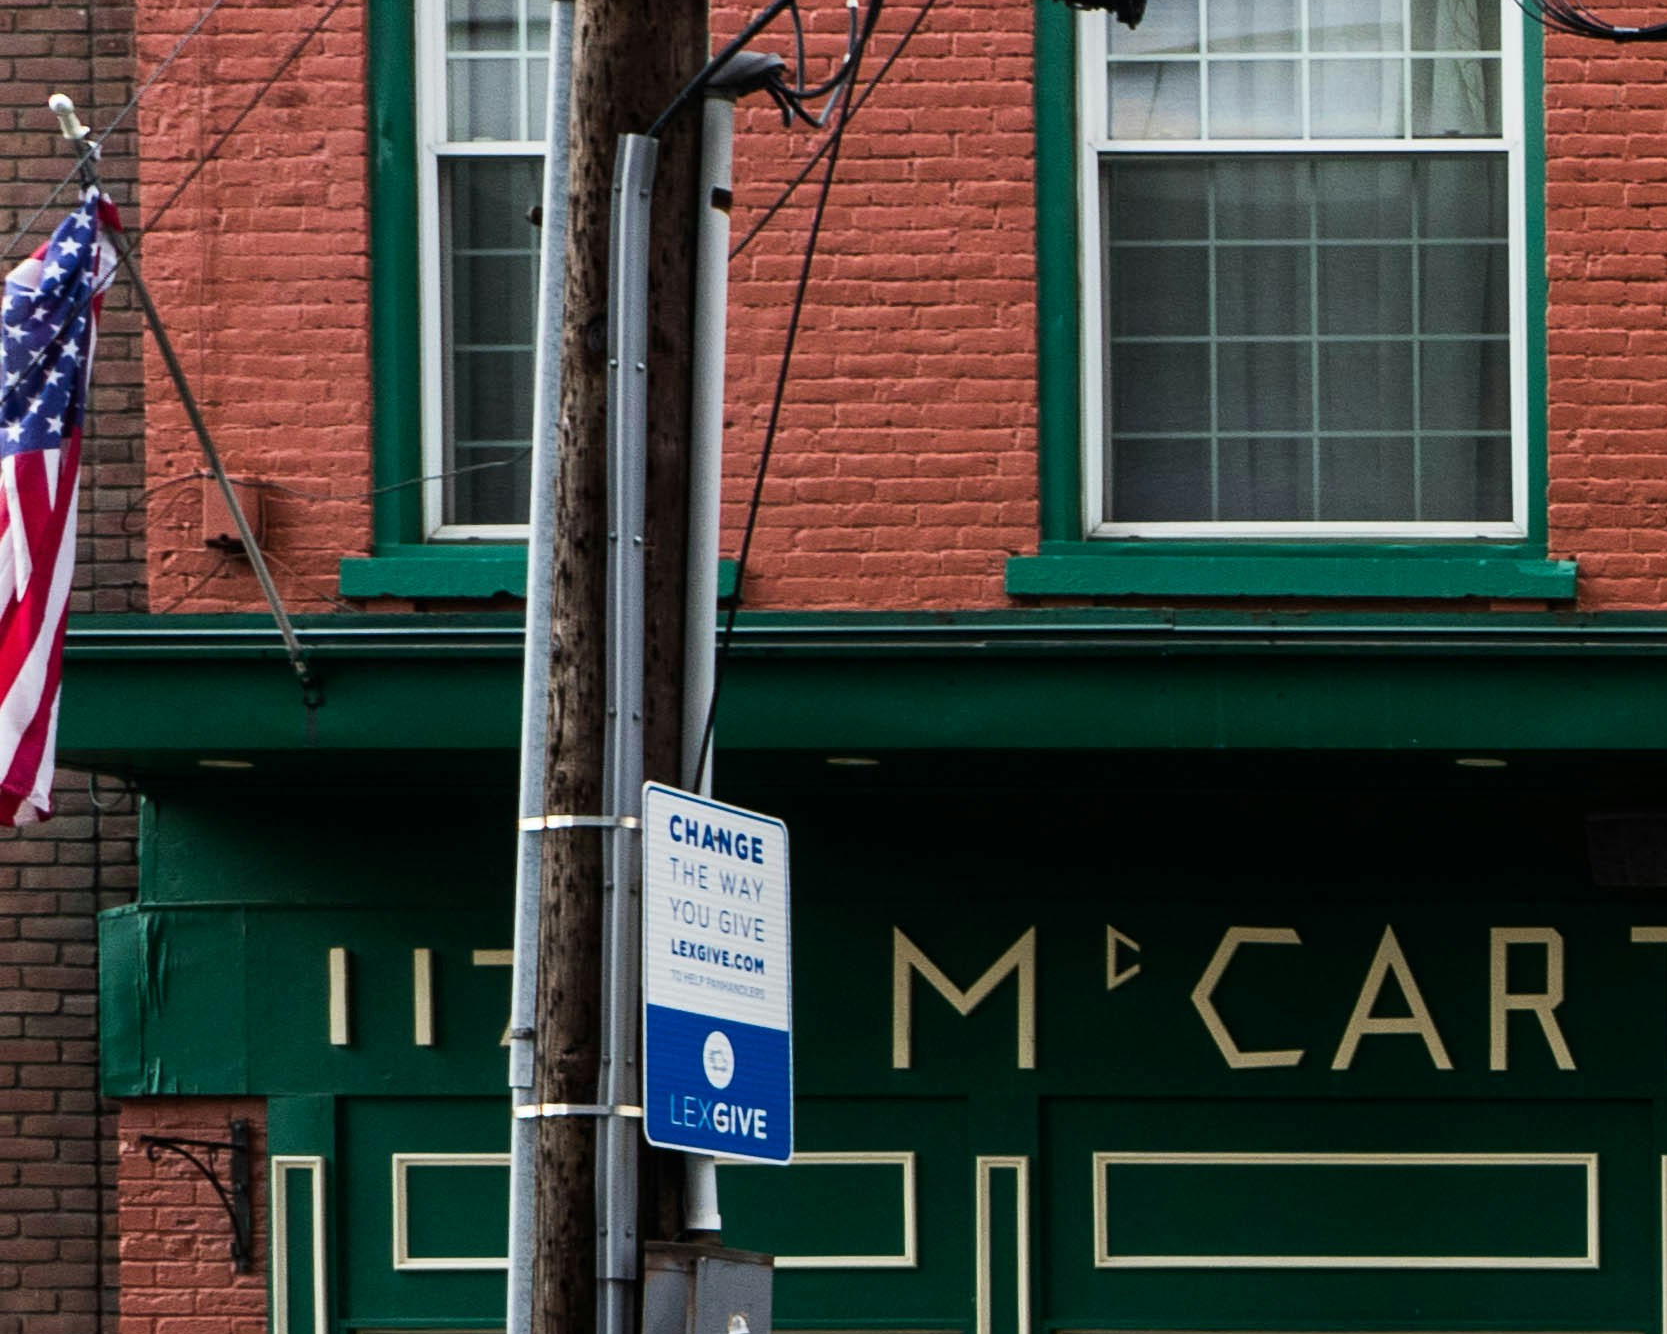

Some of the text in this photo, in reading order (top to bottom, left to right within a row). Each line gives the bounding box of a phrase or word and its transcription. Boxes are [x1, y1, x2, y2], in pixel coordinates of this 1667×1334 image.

[669, 815, 764, 865] CHANGE
[670, 857, 765, 904] THE WAY
[669, 897, 765, 942] YOU GIVE
[671, 938, 765, 975] LEXGIVE.COM
[670, 1093, 767, 1140] LEXGIVE
